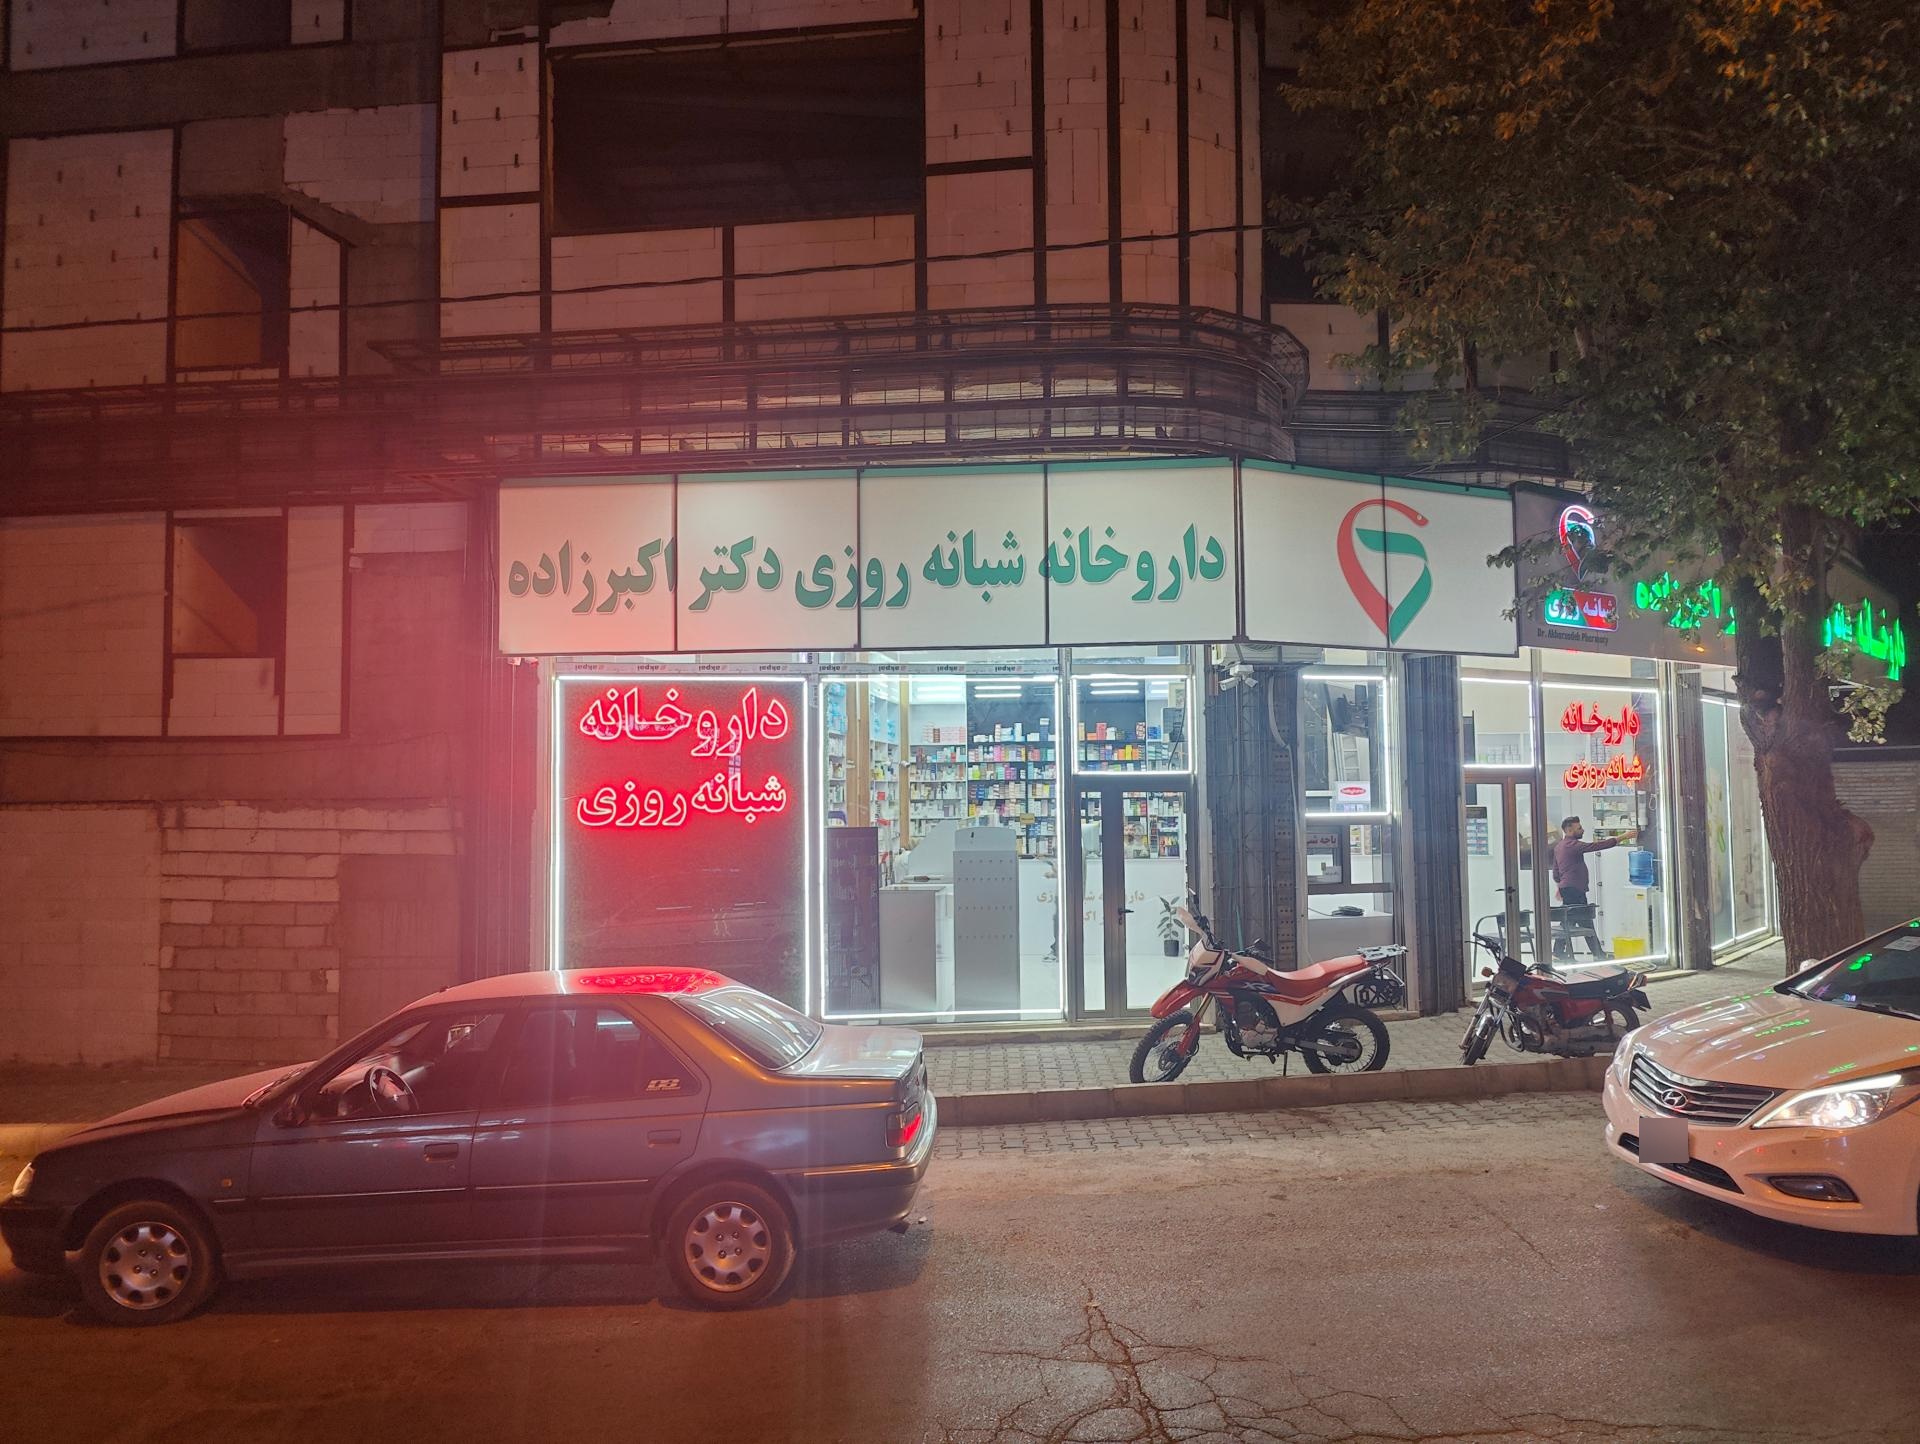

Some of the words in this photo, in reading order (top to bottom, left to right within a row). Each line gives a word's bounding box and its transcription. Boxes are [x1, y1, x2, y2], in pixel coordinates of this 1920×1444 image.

[507, 537, 676, 614] اکبرزاده
[688, 534, 782, 611] دکتر
[795, 543, 911, 609] روزی
[922, 528, 1025, 603] شبانه
[1039, 523, 1226, 603] داروخانه
[579, 688, 789, 756] داروخانه
[1561, 701, 1640, 746] داروخانه
[577, 780, 687, 826] روزی
[691, 773, 787, 824] شبانه
[1564, 760, 1607, 789] روزی
[1606, 754, 1642, 788] شبانه
